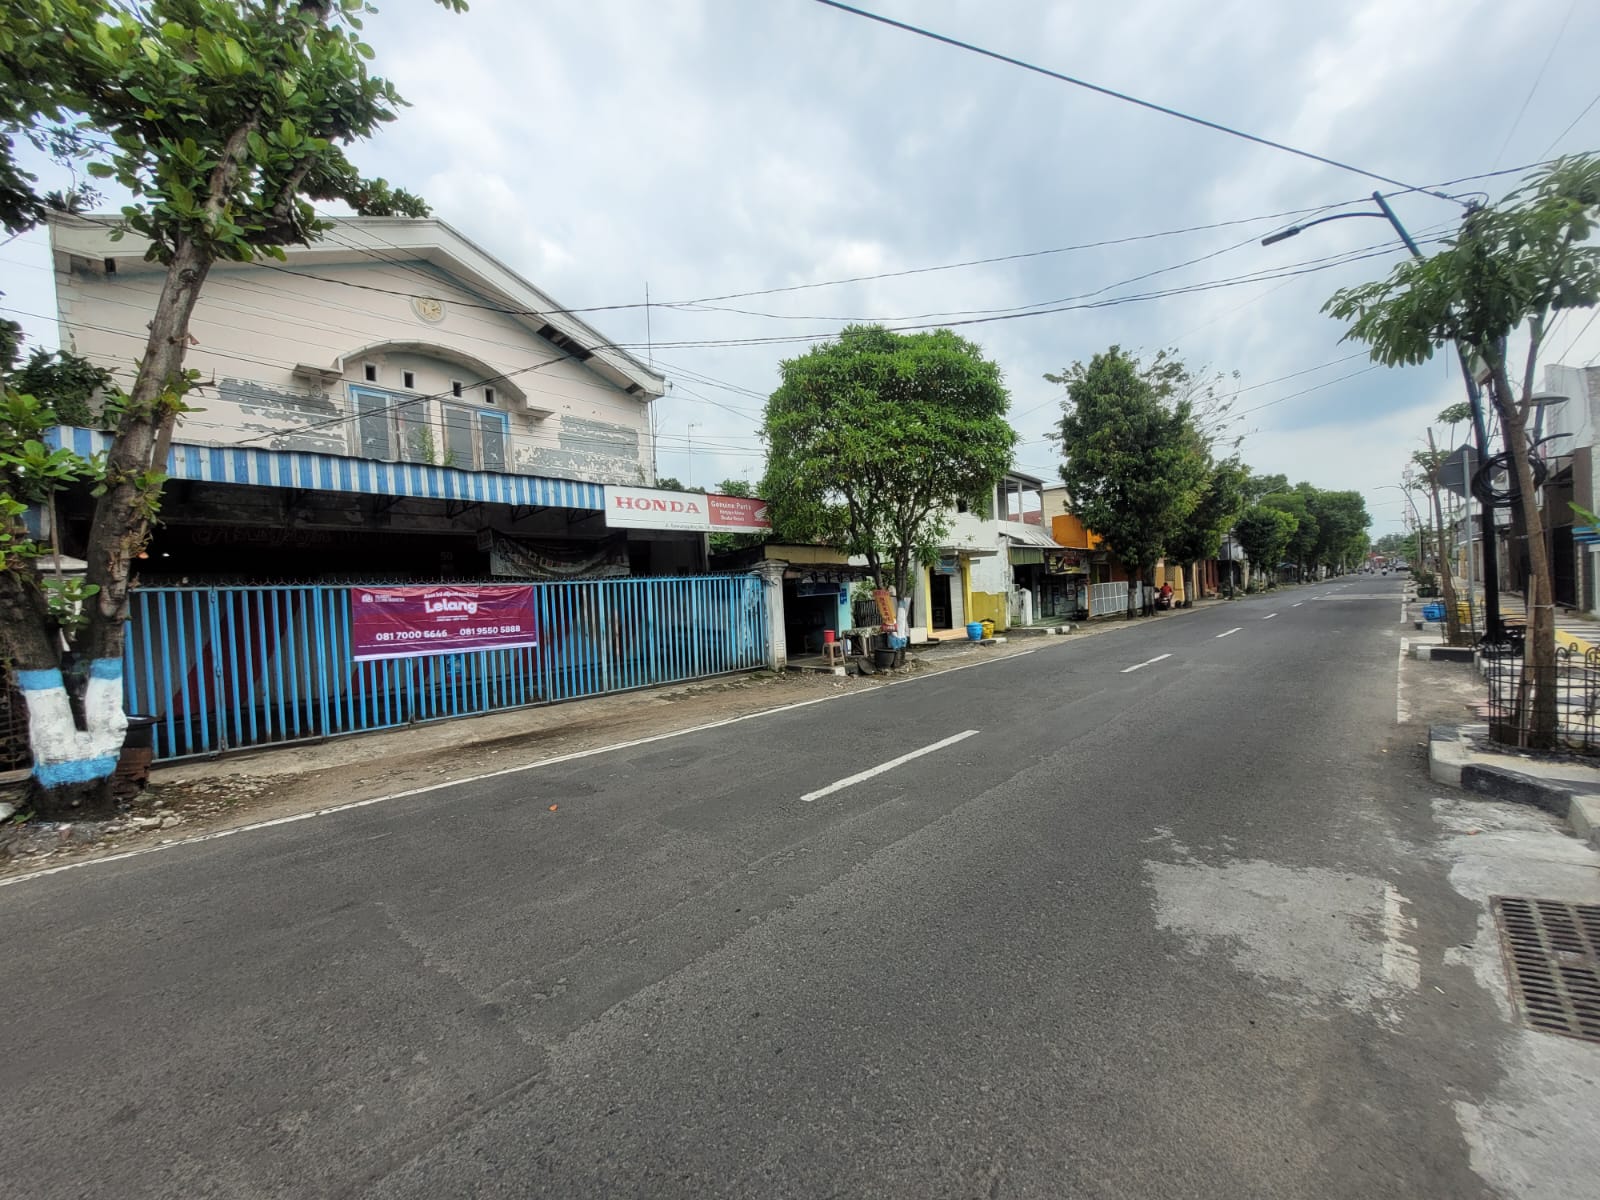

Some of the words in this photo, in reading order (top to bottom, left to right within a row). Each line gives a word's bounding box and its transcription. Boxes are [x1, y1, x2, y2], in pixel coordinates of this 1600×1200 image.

[615, 496, 702, 514] HONDA
[424, 598, 477, 614] Lelang
[376, 632, 394, 641] 081
[395, 631, 422, 640] 7000
[459, 628, 475, 636] 081
[476, 626, 499, 635] 9550
